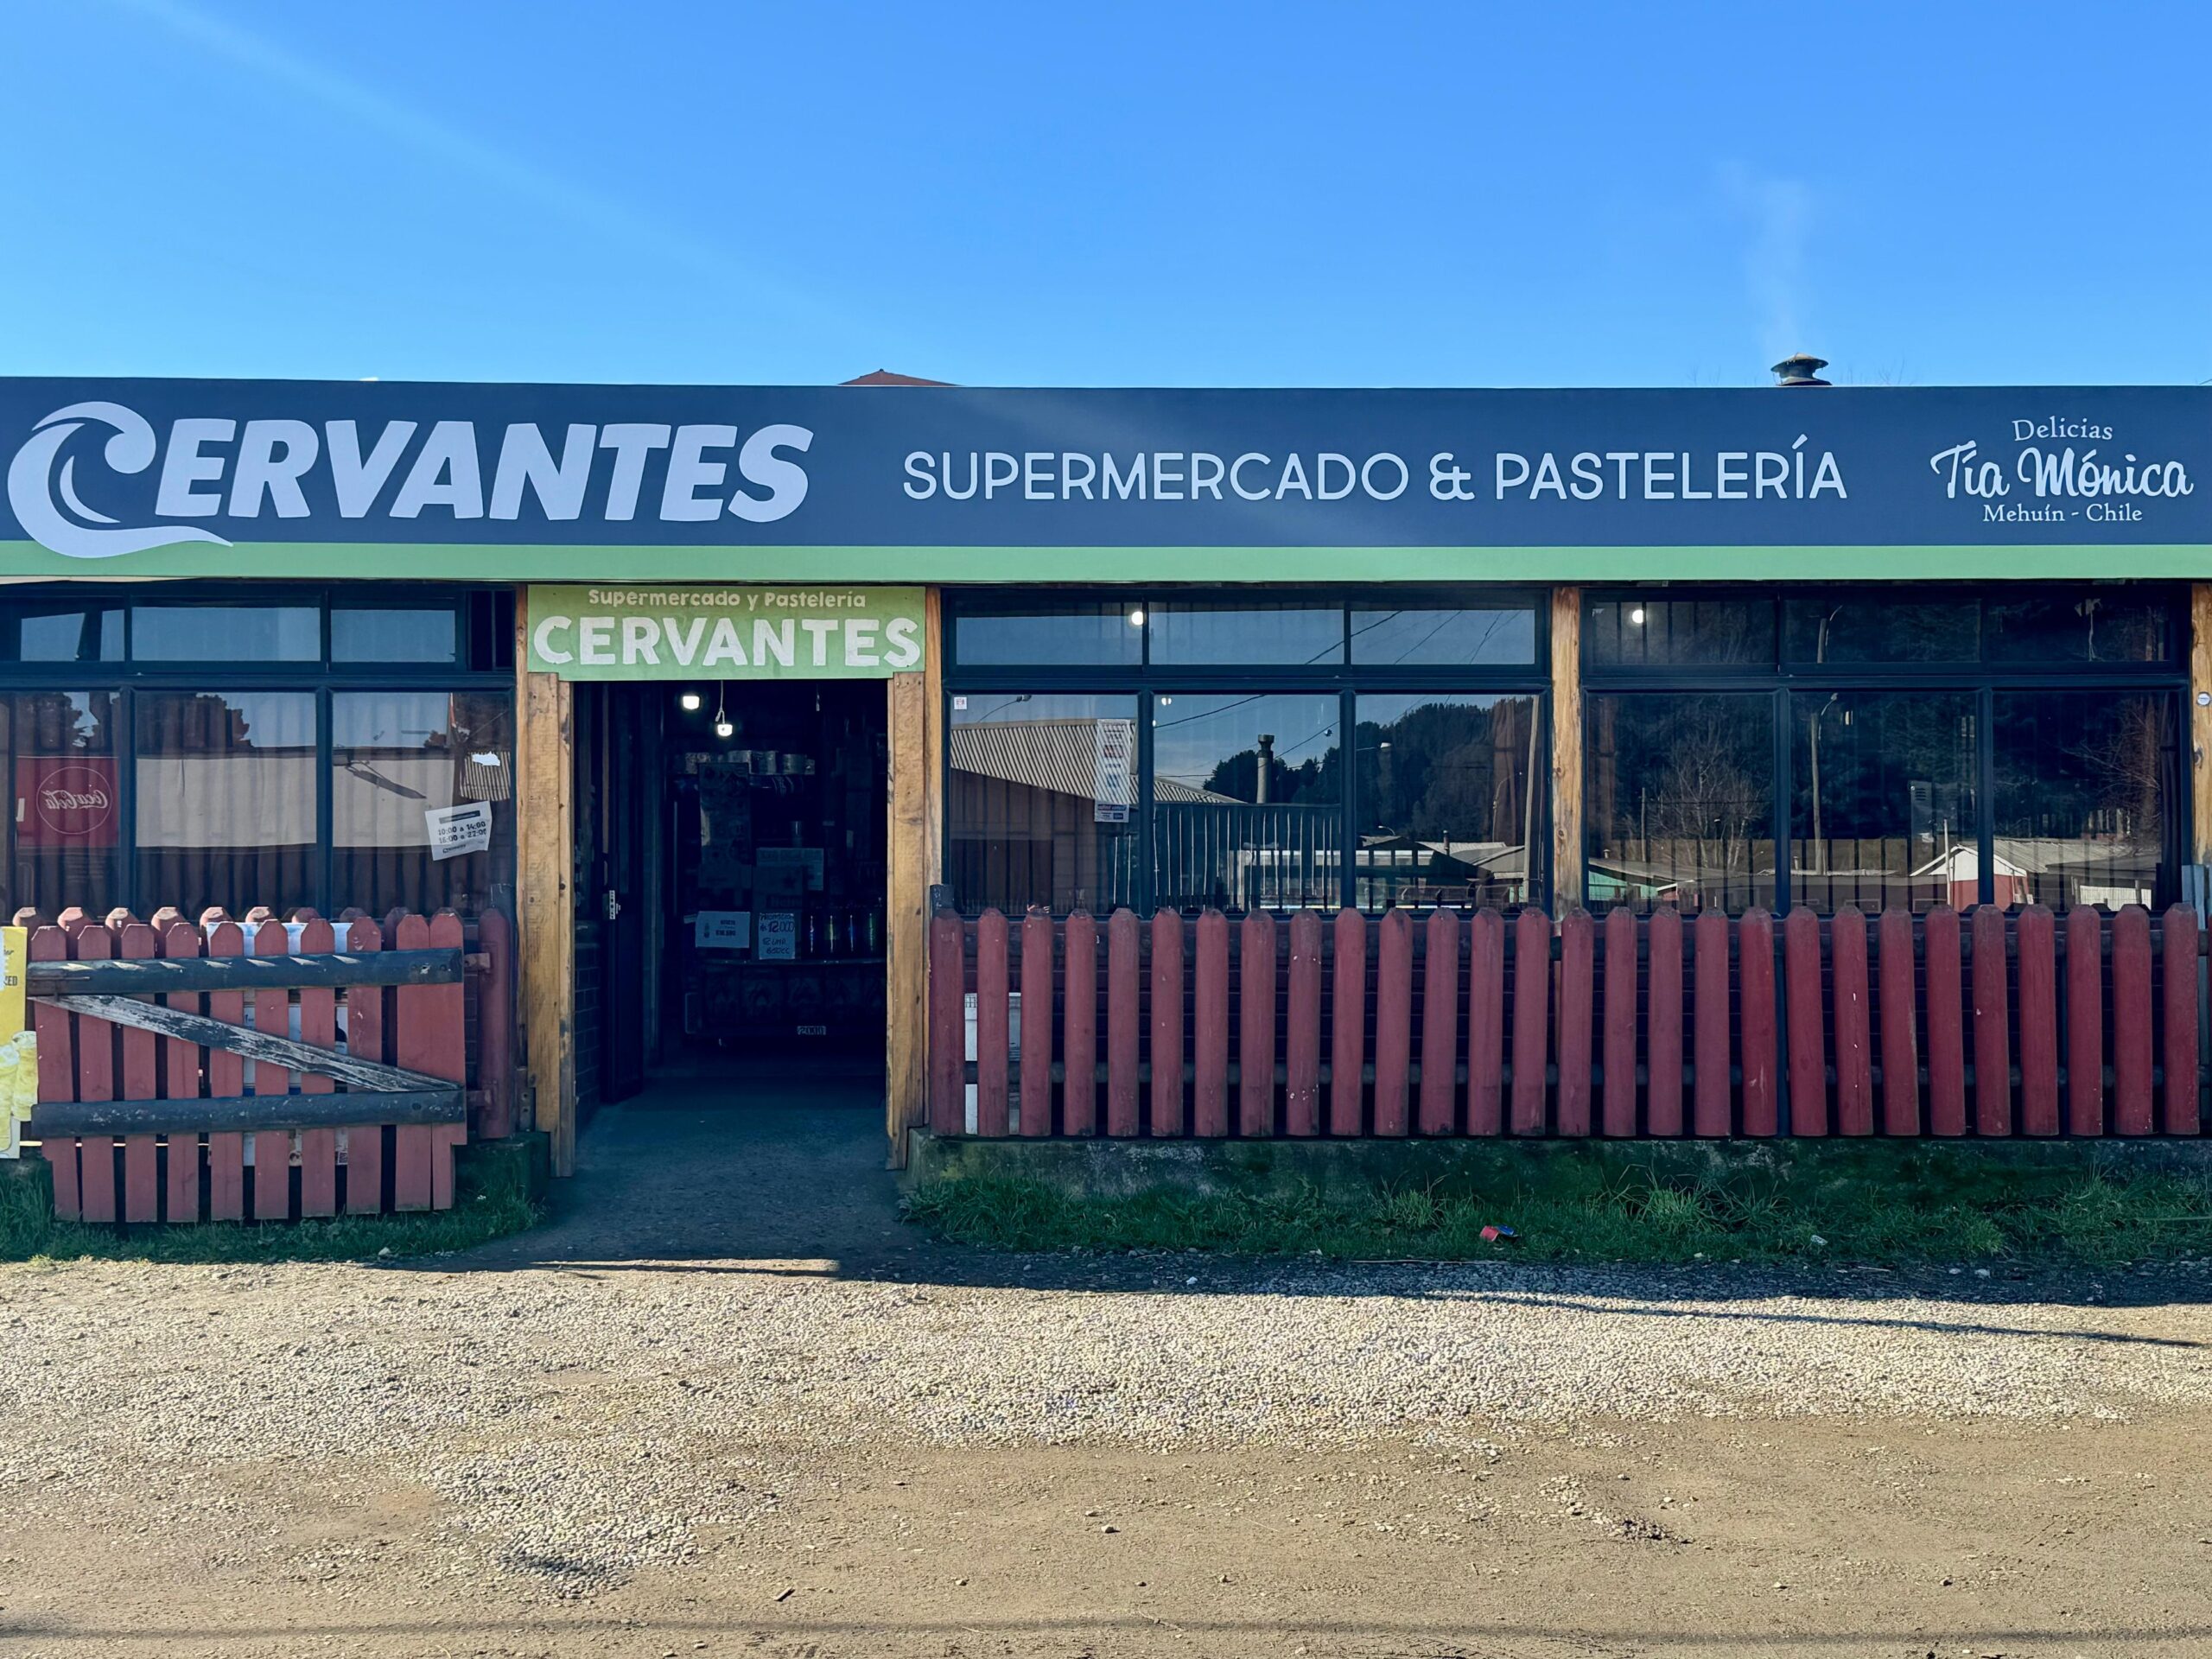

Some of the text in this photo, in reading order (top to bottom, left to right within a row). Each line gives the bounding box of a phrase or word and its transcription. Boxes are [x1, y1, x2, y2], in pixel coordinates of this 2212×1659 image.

[2012, 416, 2113, 442] Delicias
[8, 401, 814, 559] CERVANTES
[902, 434, 1848, 501] SUPERMERCADO & PASTELERÍA
[1929, 440, 2195, 499] Tía Mónica
[1982, 503, 2065, 522] Mehuín
[2085, 502, 2143, 522] Chile
[588, 589, 741, 607] Supermercado
[747, 594, 758, 612] y
[533, 616, 921, 668] CERVANTES
